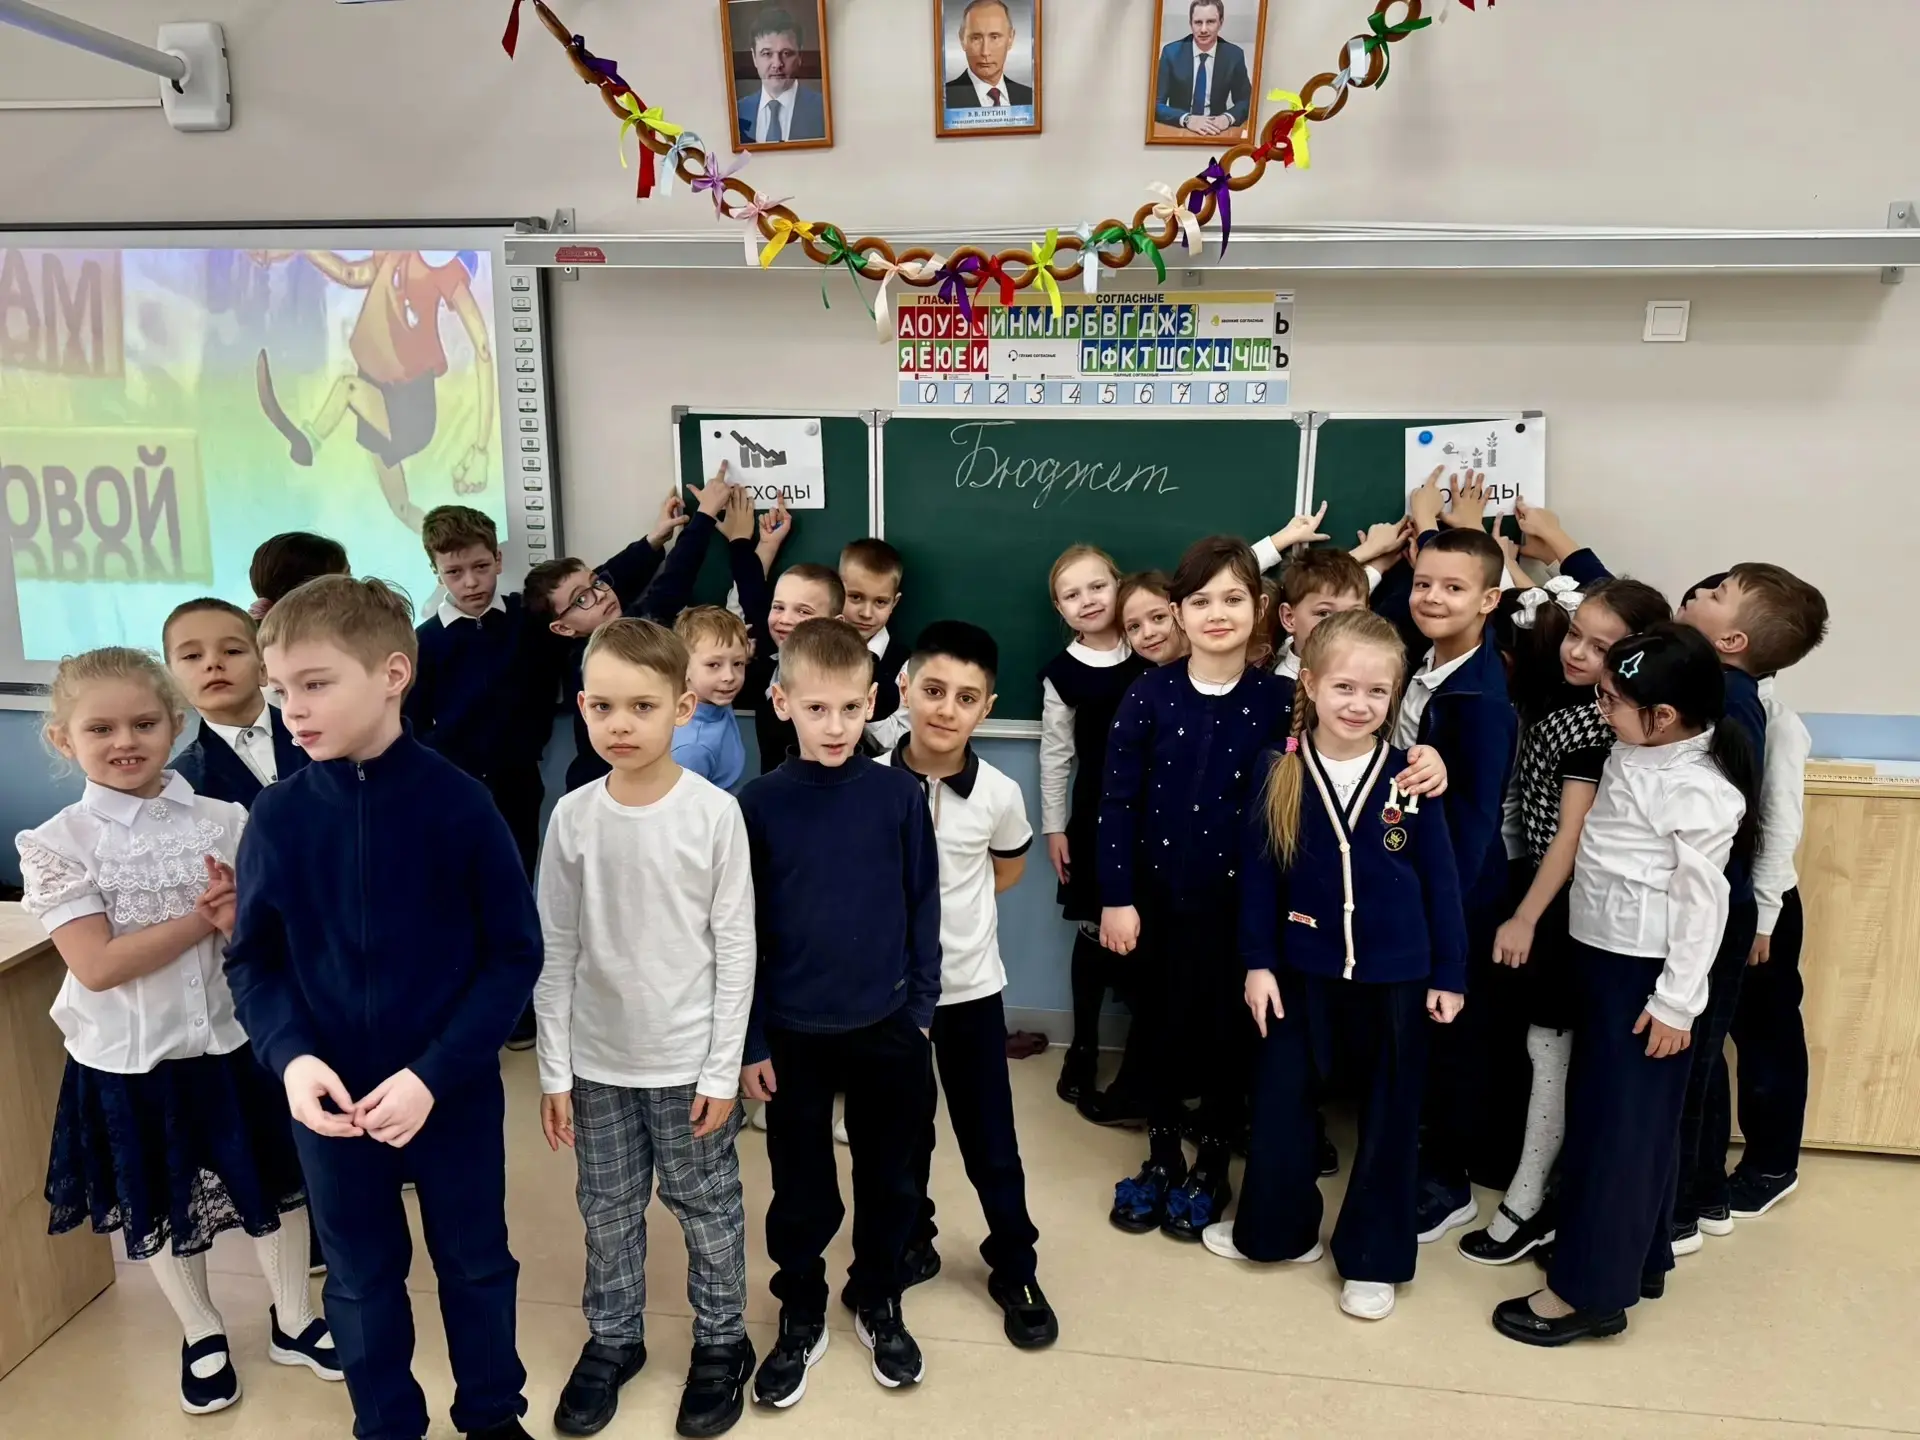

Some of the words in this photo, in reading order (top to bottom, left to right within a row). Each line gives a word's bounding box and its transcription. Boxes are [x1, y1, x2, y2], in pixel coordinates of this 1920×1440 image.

[917, 295, 969, 305] ГЛАСЫ
[1095, 293, 1165, 304] СОГЛАСНЫЕ
[924, 383, 938, 403] 0
[963, 383, 973, 403] 1
[995, 383, 1009, 403] 2
[1030, 383, 1045, 403] 3
[1068, 383, 1081, 403] 4
[1102, 383, 1117, 403] 5
[1140, 383, 1154, 403] 6
[1177, 383, 1191, 403] 7
[1215, 383, 1229, 403] 8
[1253, 383, 1267, 403] 9
[950, 420, 1180, 509] Бюджет
[730, 485, 811, 504] ХОДЫ
